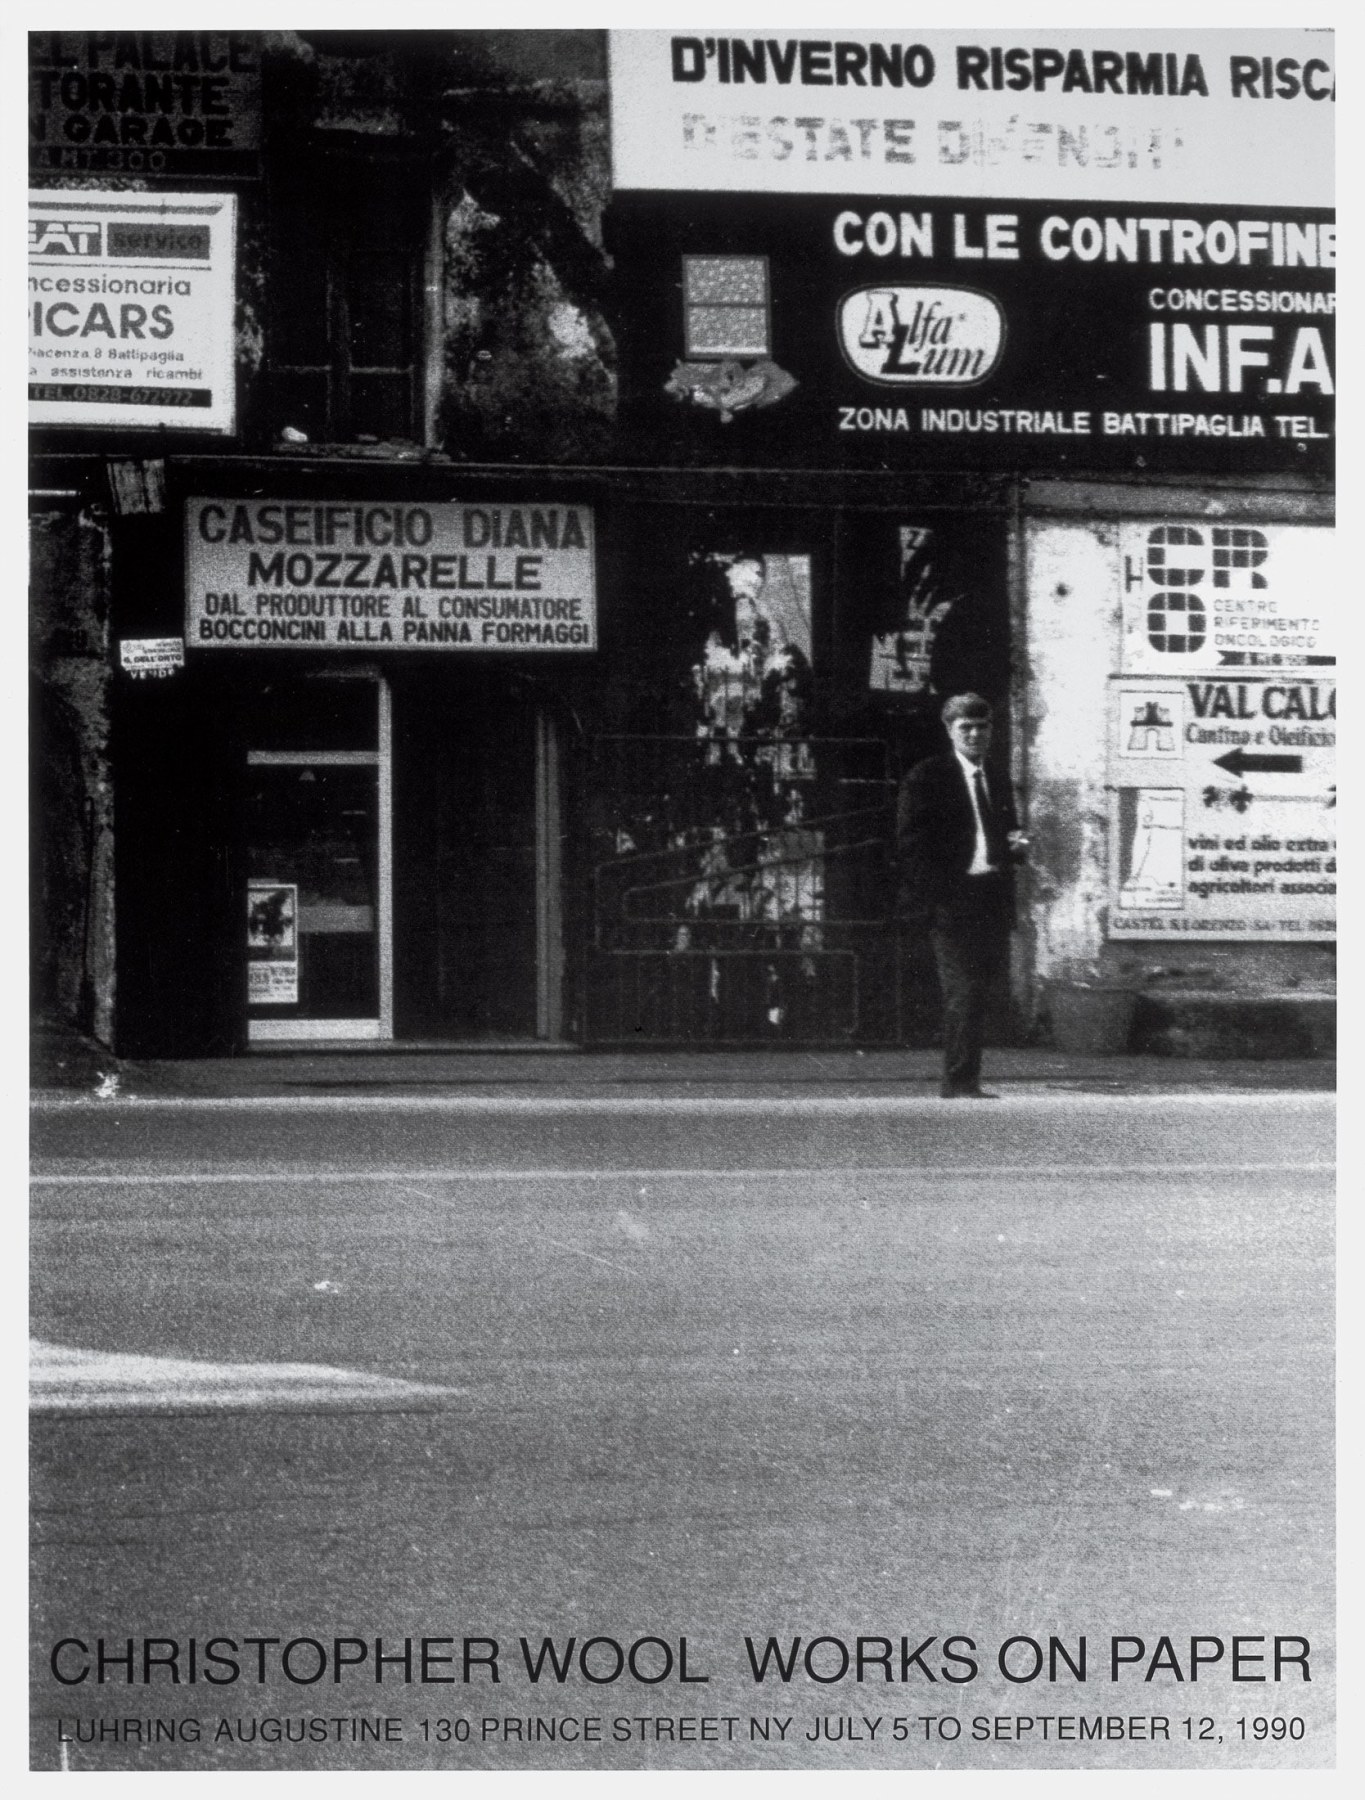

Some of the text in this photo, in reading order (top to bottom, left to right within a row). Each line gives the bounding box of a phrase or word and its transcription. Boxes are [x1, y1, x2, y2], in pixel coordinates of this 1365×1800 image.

[88, 31, 256, 73] PALACE
[671, 37, 1335, 102] D'INVERNO RISPARMIA RISC
[63, 114, 233, 146] GARAGE
[682, 112, 917, 165] DESTATE
[834, 212, 1336, 269] CON LE CONTROFINE
[28, 274, 192, 296] ncessionaria
[1150, 287, 1336, 315] CONCESSIONAR
[28, 301, 175, 340] ICARS
[858, 291, 953, 353] Alfa
[50, 367, 133, 379] assistenza
[146, 367, 203, 380] ricambi
[1150, 322, 1336, 395] INF.A
[838, 407, 1330, 439] ZONA INDUSTRIALE BATTIPAGLIA TEL
[200, 504, 587, 550] CASEIFICIO DIANA
[247, 551, 544, 591] MOZZARELLE
[205, 592, 582, 621] DAL PRODUTTORE AL CONSUMATORE
[200, 618, 589, 644] BOCCONCINI ALLA PANNA FORMAGGI
[1187, 684, 1257, 719] VAL
[1224, 834, 1245, 851] ed
